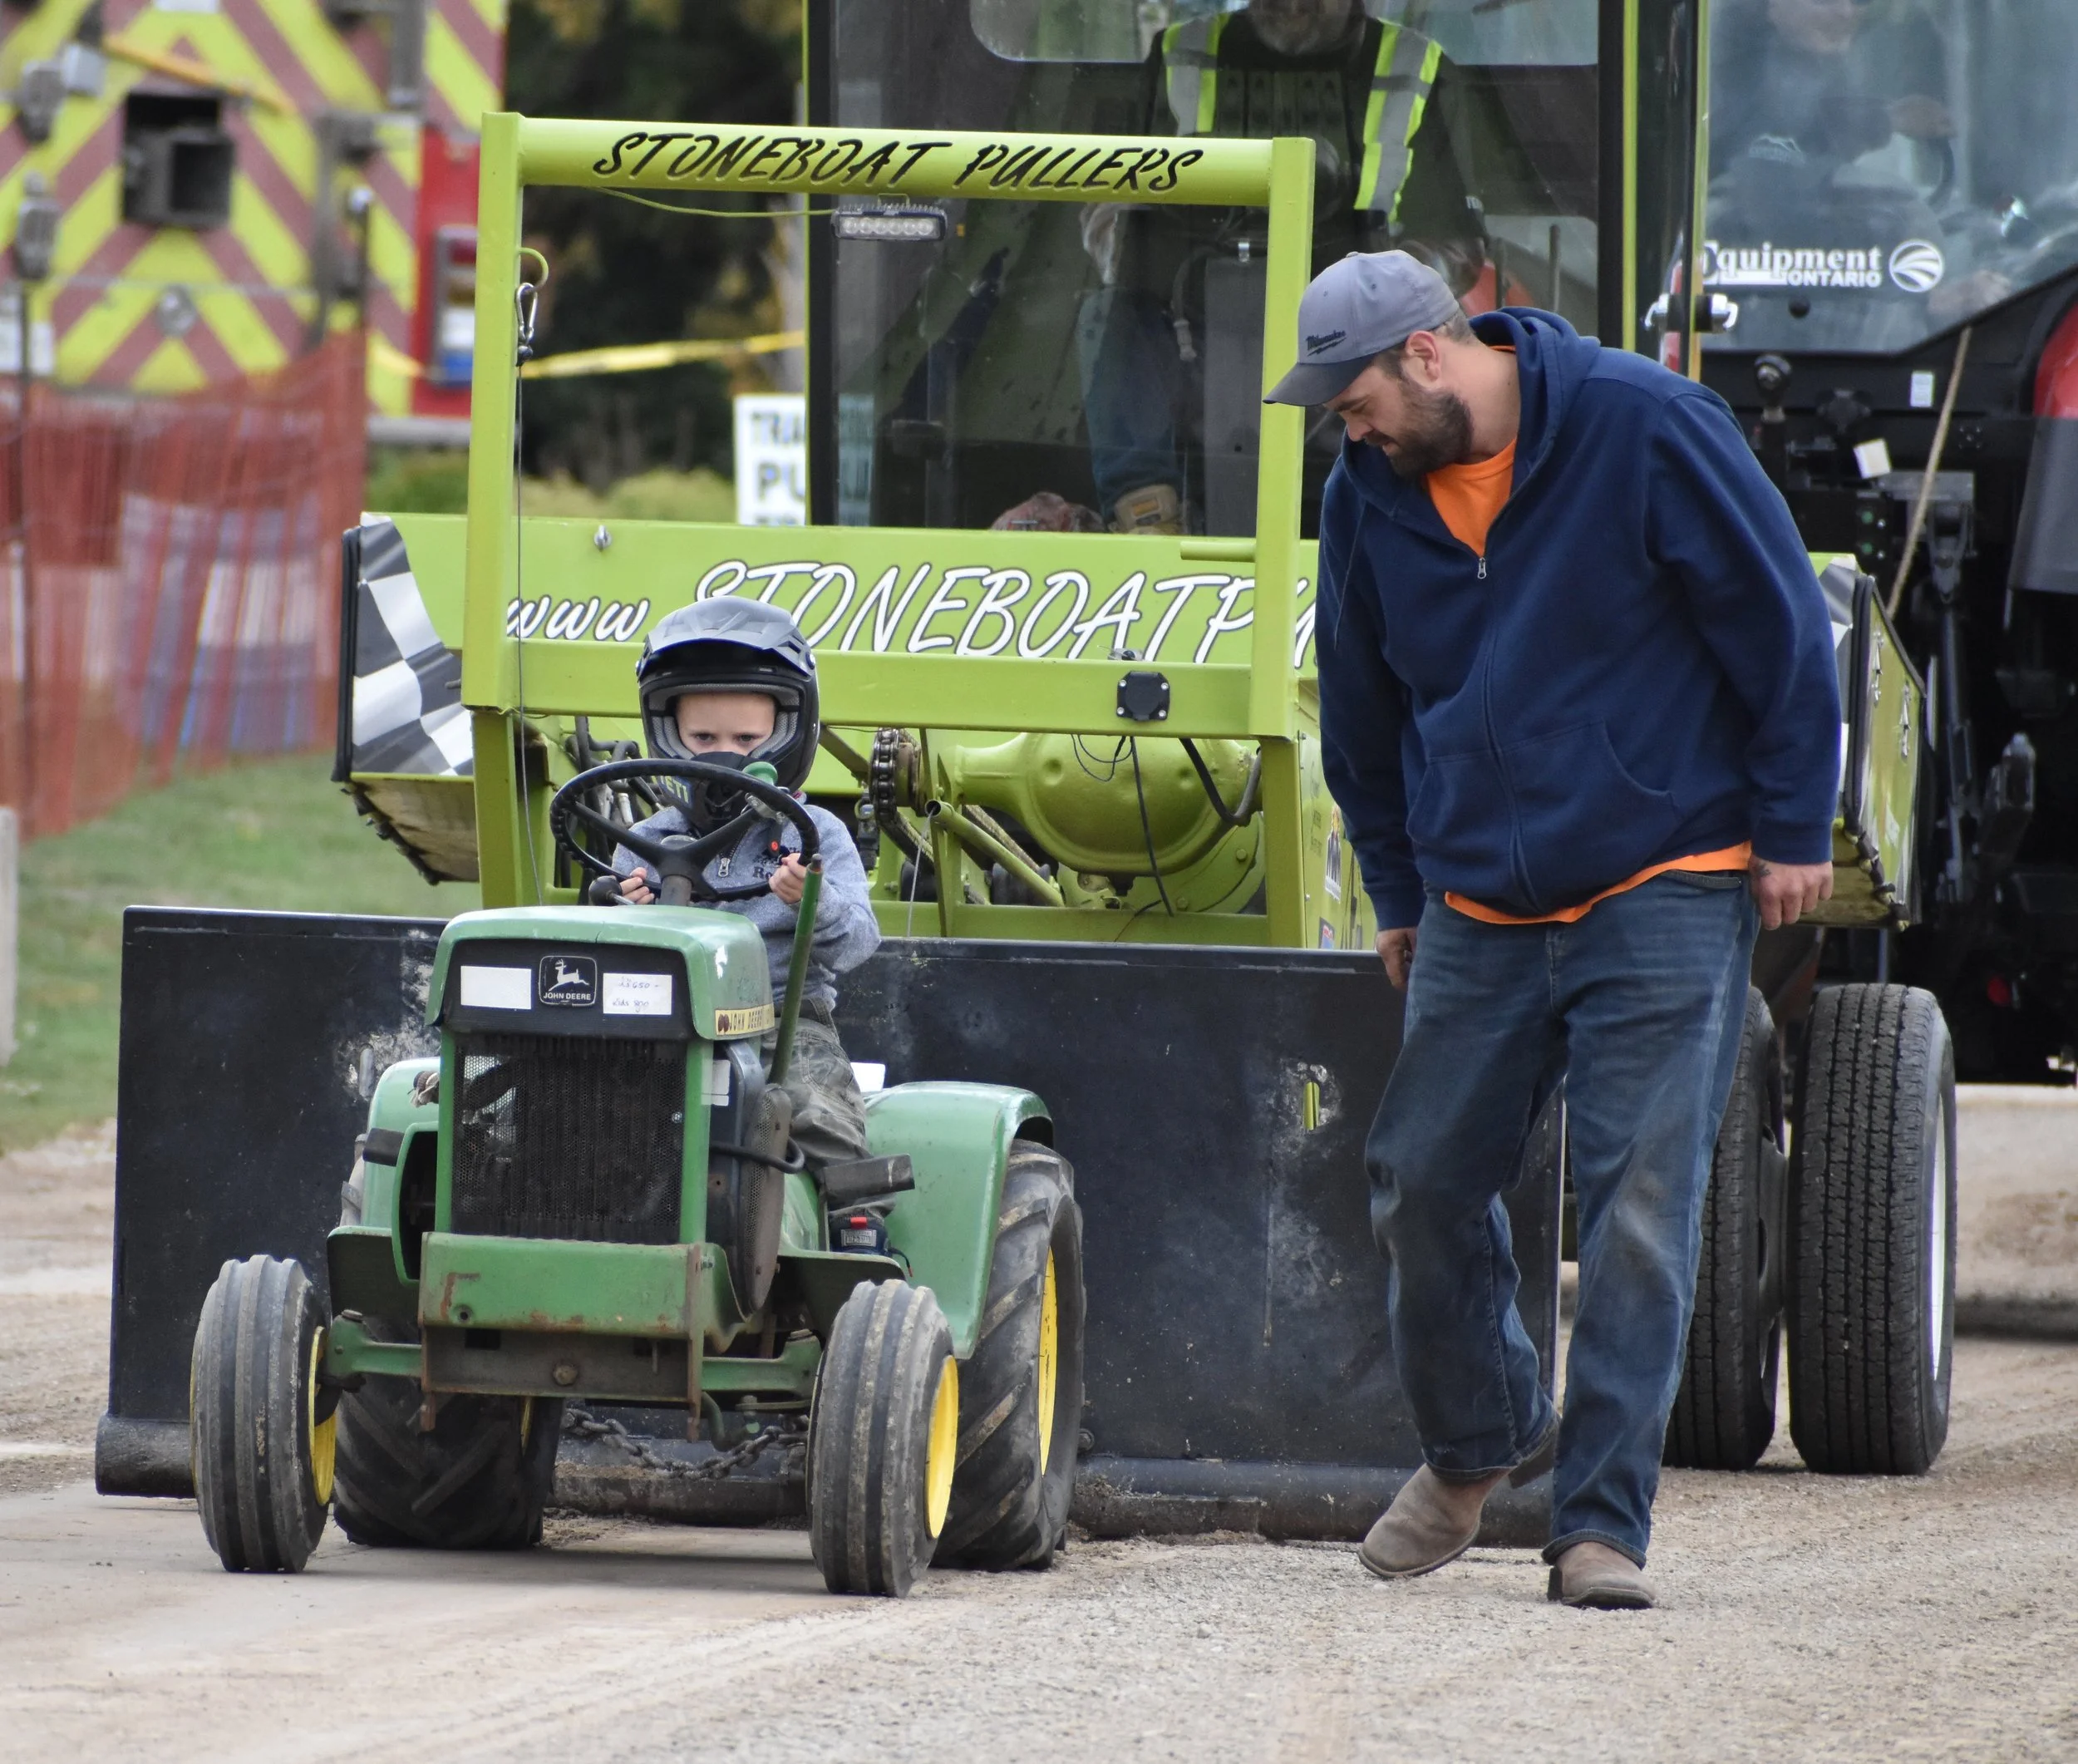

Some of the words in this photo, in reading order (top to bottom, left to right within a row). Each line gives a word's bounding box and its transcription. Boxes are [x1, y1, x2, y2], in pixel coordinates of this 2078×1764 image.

[593, 131, 952, 188] STONEBOAT
[953, 143, 1204, 194] PULLERS
[1790, 271, 1881, 288] ONTARIO
[660, 775, 689, 804] ETI
[565, 993, 591, 1001] DEERE
[729, 1012, 746, 1032] JOHN
[747, 1008, 763, 1029] DEERE
